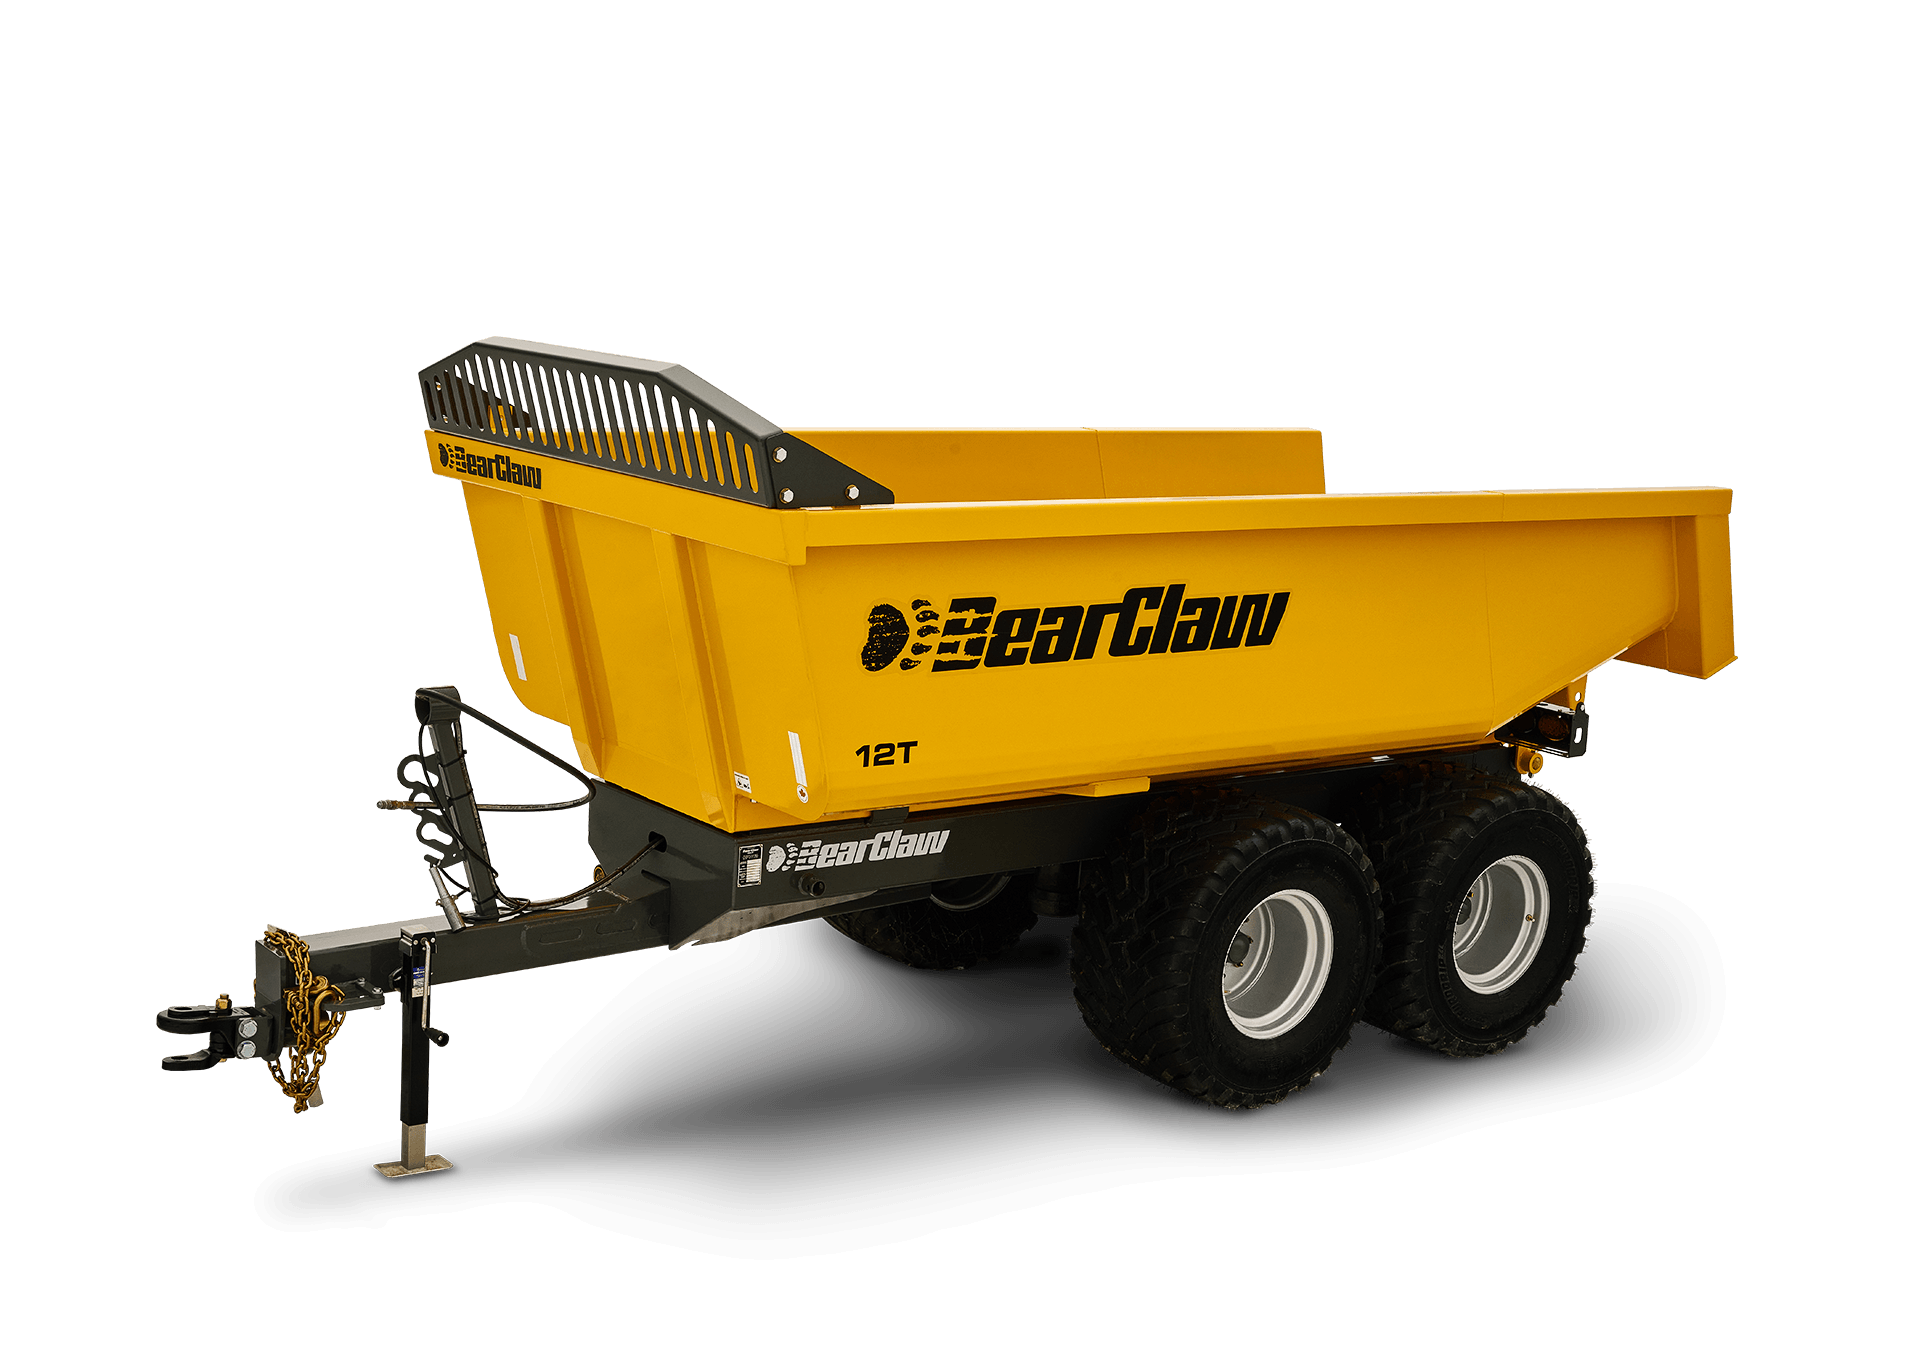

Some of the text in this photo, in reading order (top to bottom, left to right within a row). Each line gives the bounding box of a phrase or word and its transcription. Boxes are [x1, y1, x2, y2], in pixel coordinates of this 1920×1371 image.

[454, 445, 542, 490] BearClaw
[930, 583, 1291, 673] BearClaw
[855, 740, 919, 768] 12T
[794, 829, 951, 872] BearClaw
